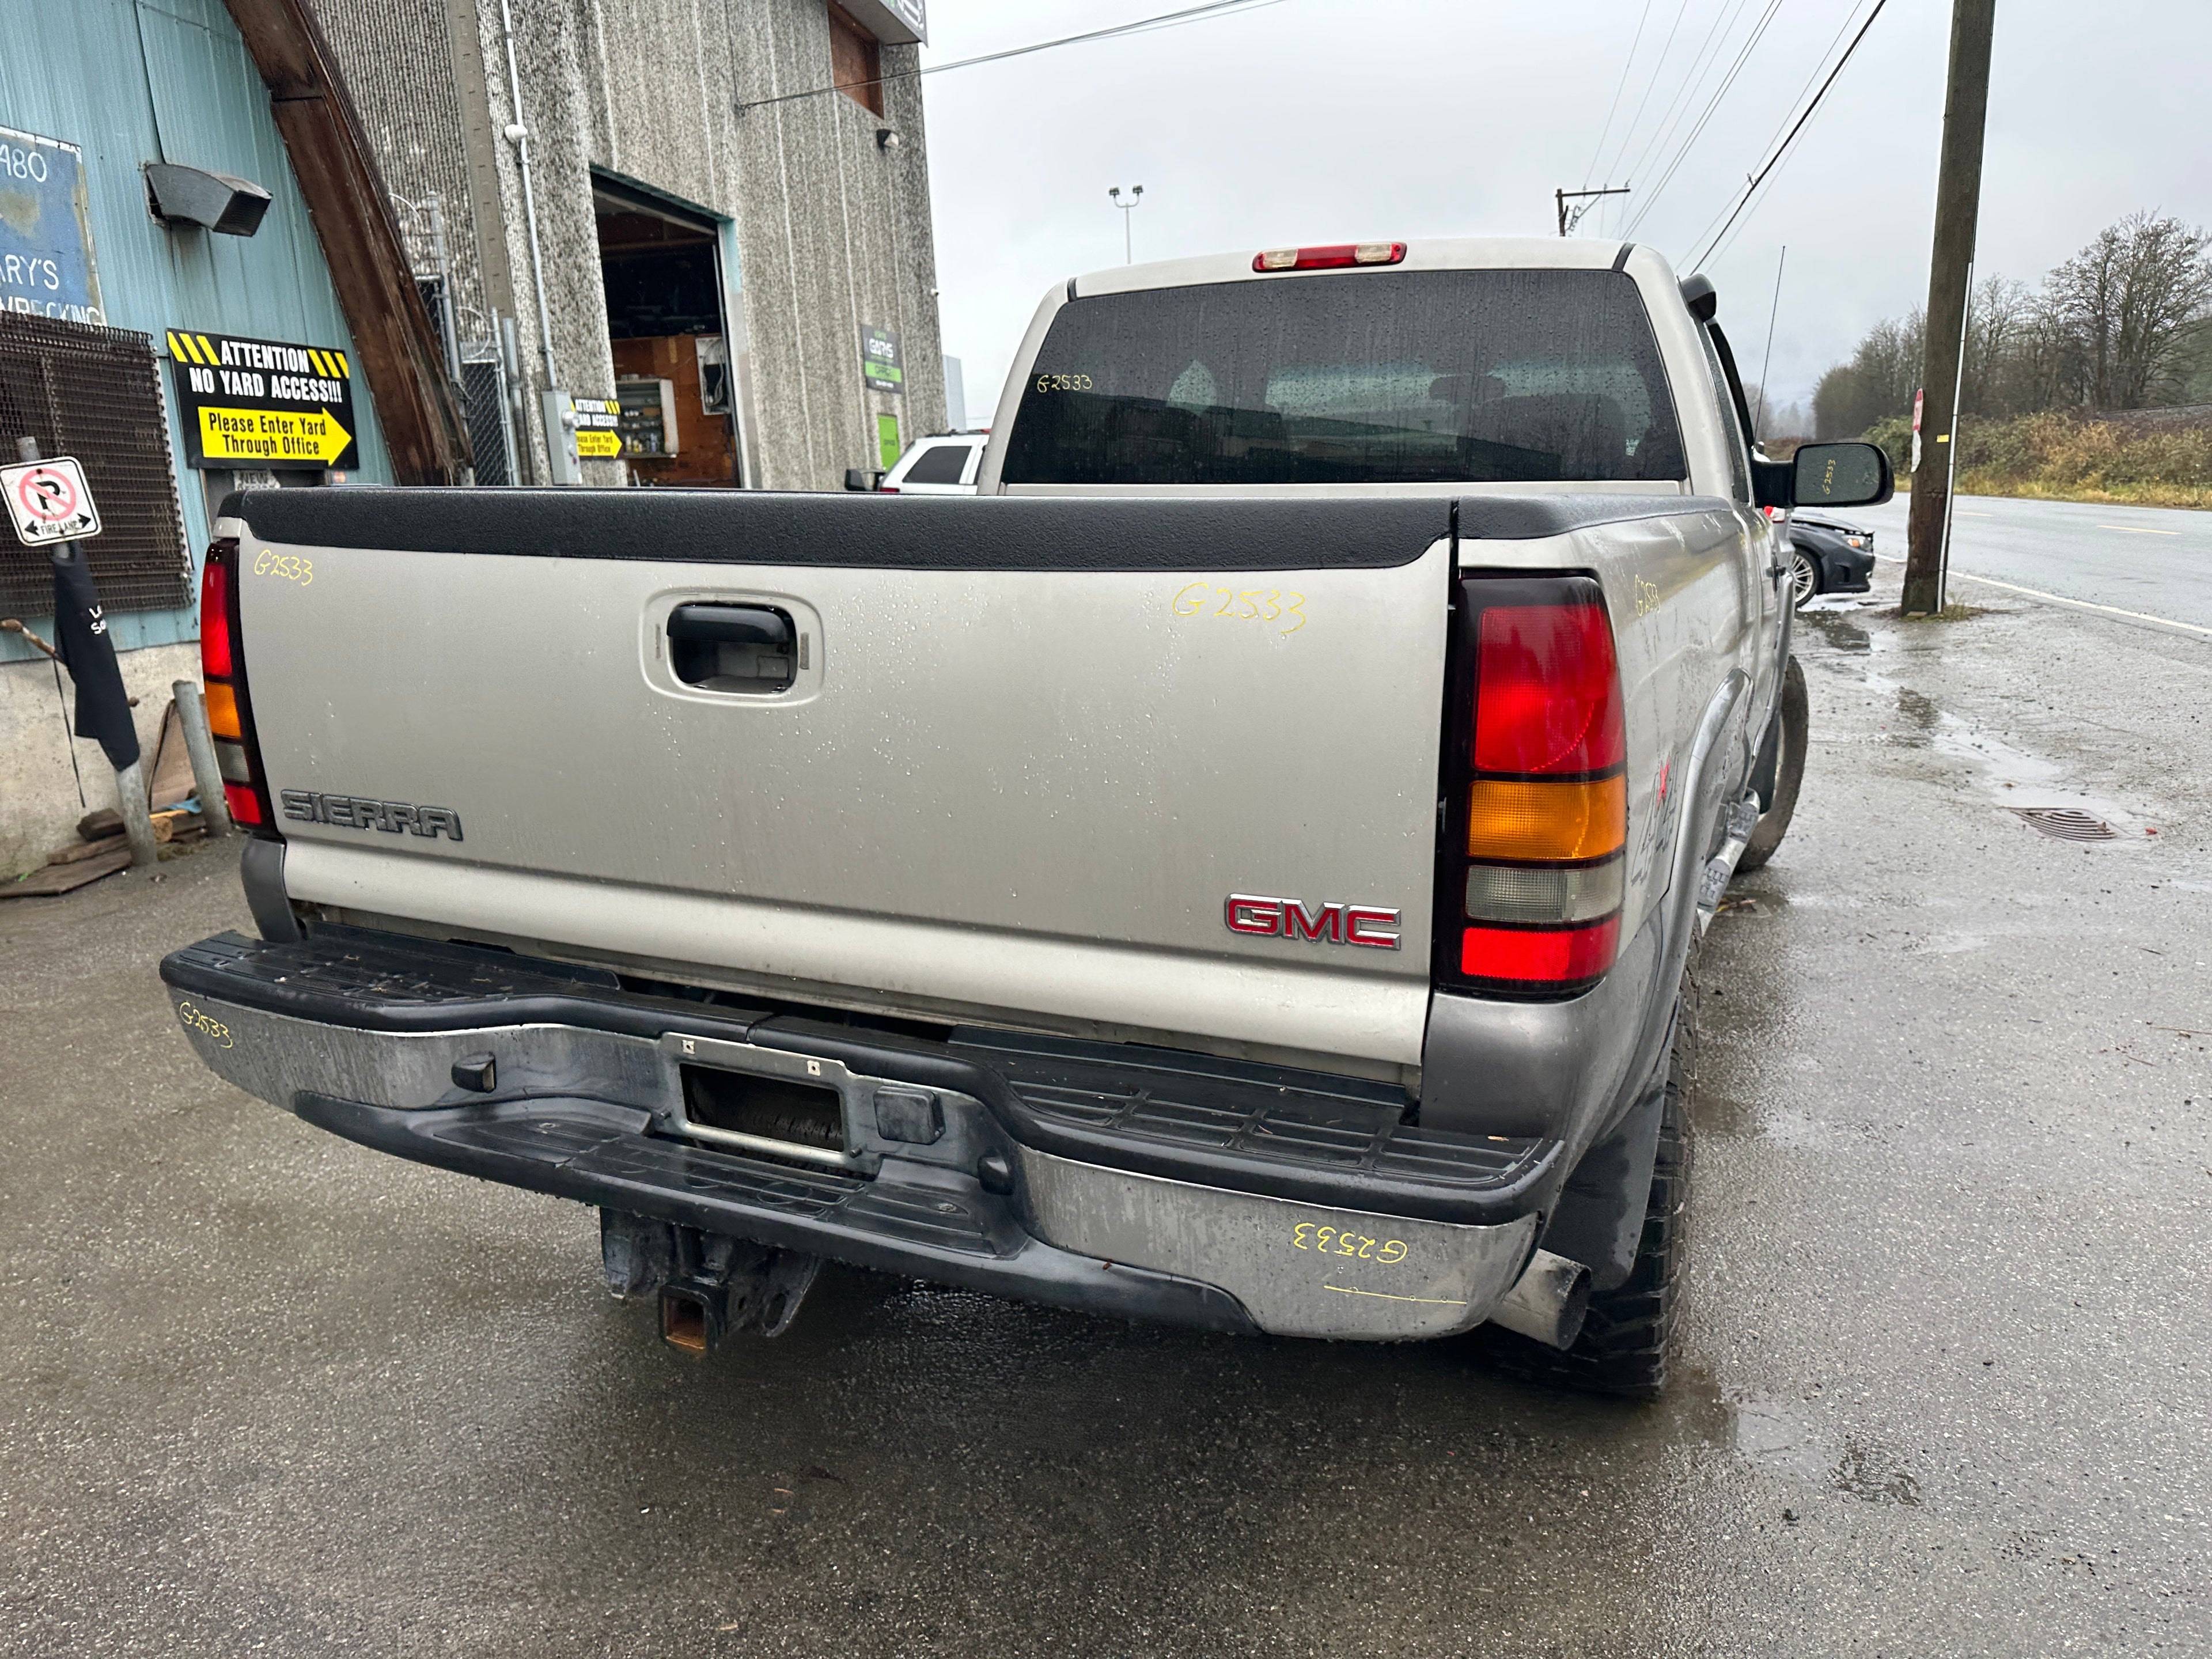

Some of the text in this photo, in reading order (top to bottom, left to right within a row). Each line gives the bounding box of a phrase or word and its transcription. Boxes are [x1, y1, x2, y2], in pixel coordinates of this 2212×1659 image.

[221, 340, 310, 373] ATTENTION
[189, 367, 342, 403] NO YARD ACCESS!!!
[1037, 374, 1092, 392] G2533
[575, 399, 606, 413] ATTENTION
[576, 413, 591, 426] ARD
[209, 412, 327, 435] Please Enter Yard
[222, 434, 320, 456] Through Office
[40, 523, 58, 535] FIRE
[254, 548, 313, 586] G2533
[281, 789, 463, 841] SIERRA
[1225, 893, 1402, 951] GMC
[180, 1001, 233, 1048] G2533
[1293, 1222, 1408, 1264] G2533
